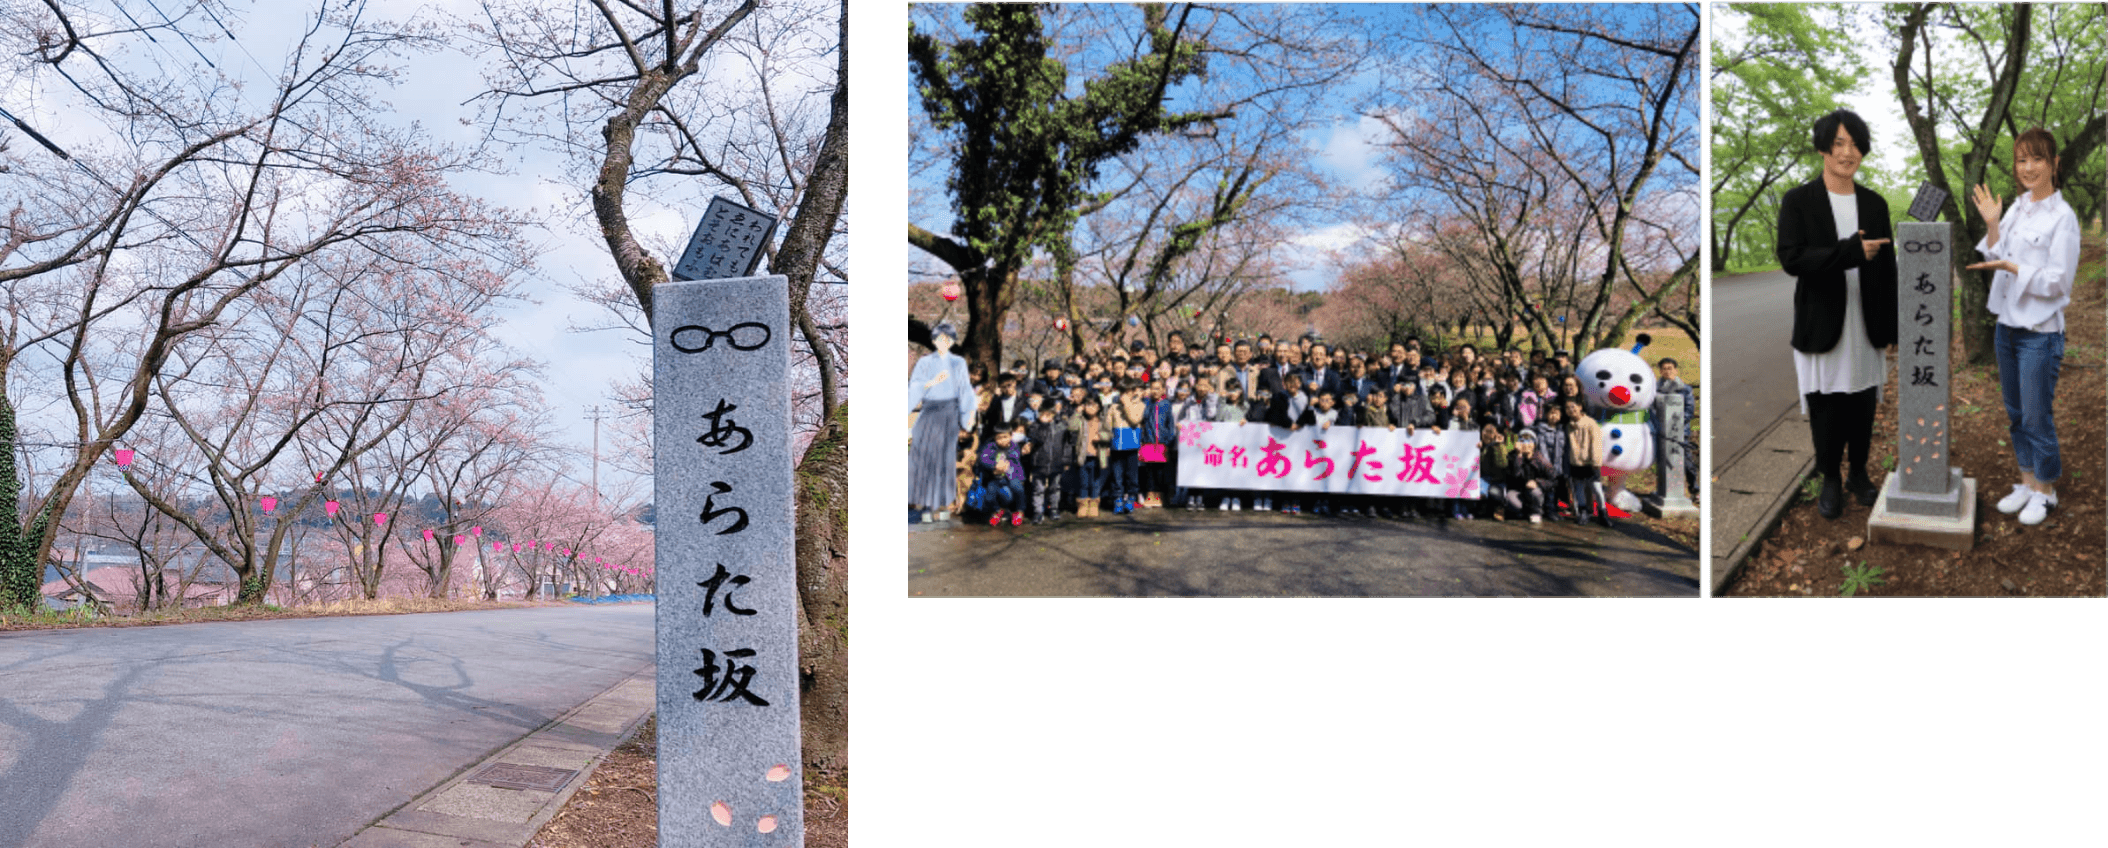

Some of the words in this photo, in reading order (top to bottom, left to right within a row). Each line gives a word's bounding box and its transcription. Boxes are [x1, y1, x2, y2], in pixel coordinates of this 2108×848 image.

[1911, 272, 1939, 387] あらた坂
[1203, 443, 1249, 469] 命名
[1255, 436, 1442, 485] あらた坂
[692, 398, 771, 707] あらた坂
